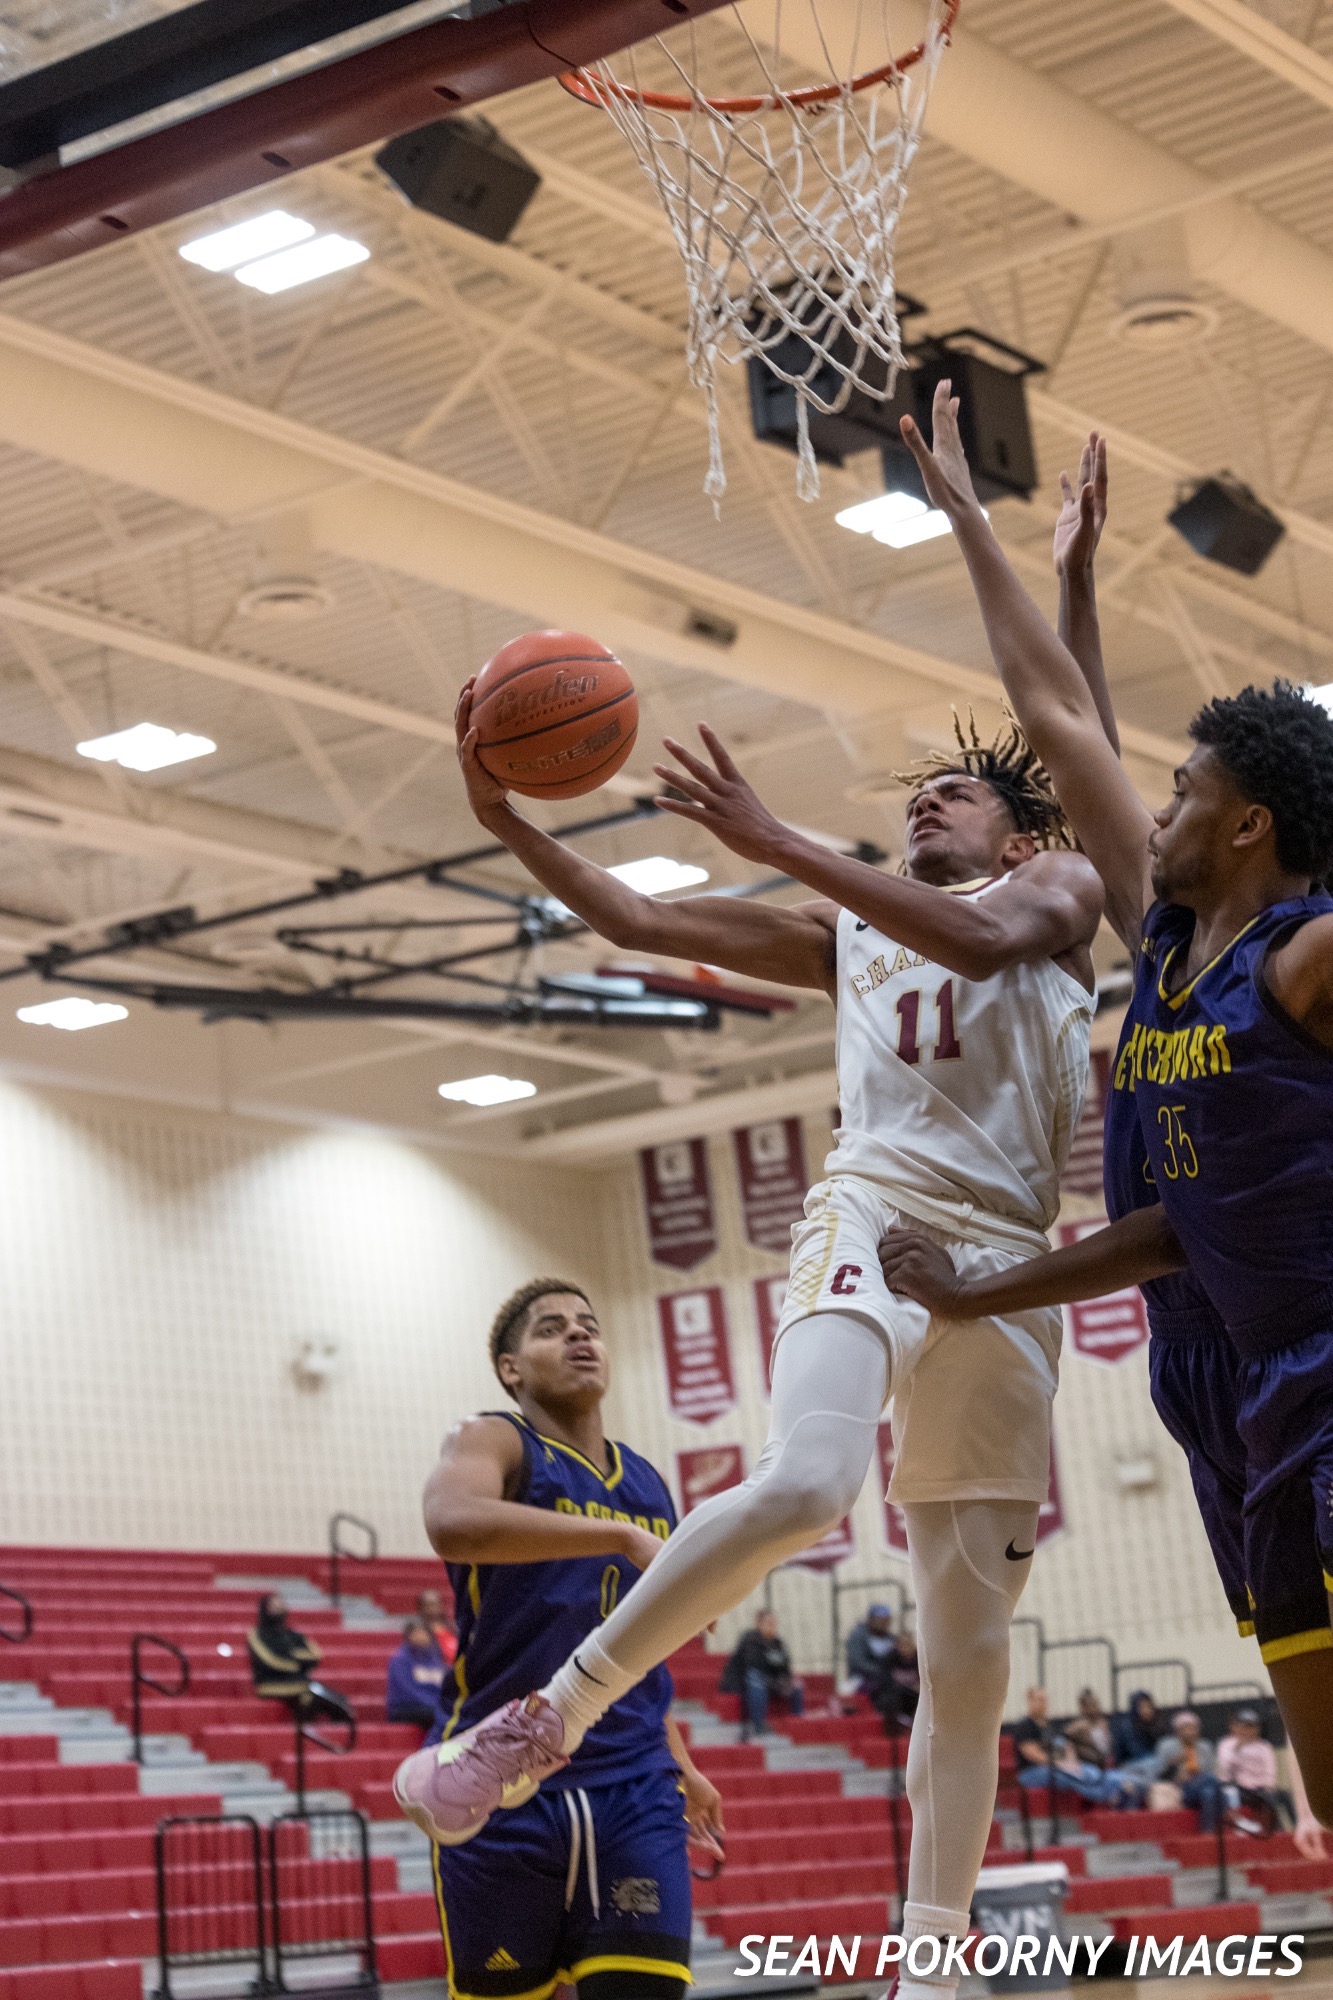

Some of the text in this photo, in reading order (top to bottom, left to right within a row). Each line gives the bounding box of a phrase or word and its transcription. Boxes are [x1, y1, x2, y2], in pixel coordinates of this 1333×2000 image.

[495, 670, 599, 726] Baden
[506, 741, 589, 771] ELITE
[850, 947, 934, 1001] CHA
[893, 975, 964, 1067] 11
[1157, 1104, 1199, 1180] 35
[830, 1263, 864, 1296] C
[600, 1564, 621, 1619] 0
